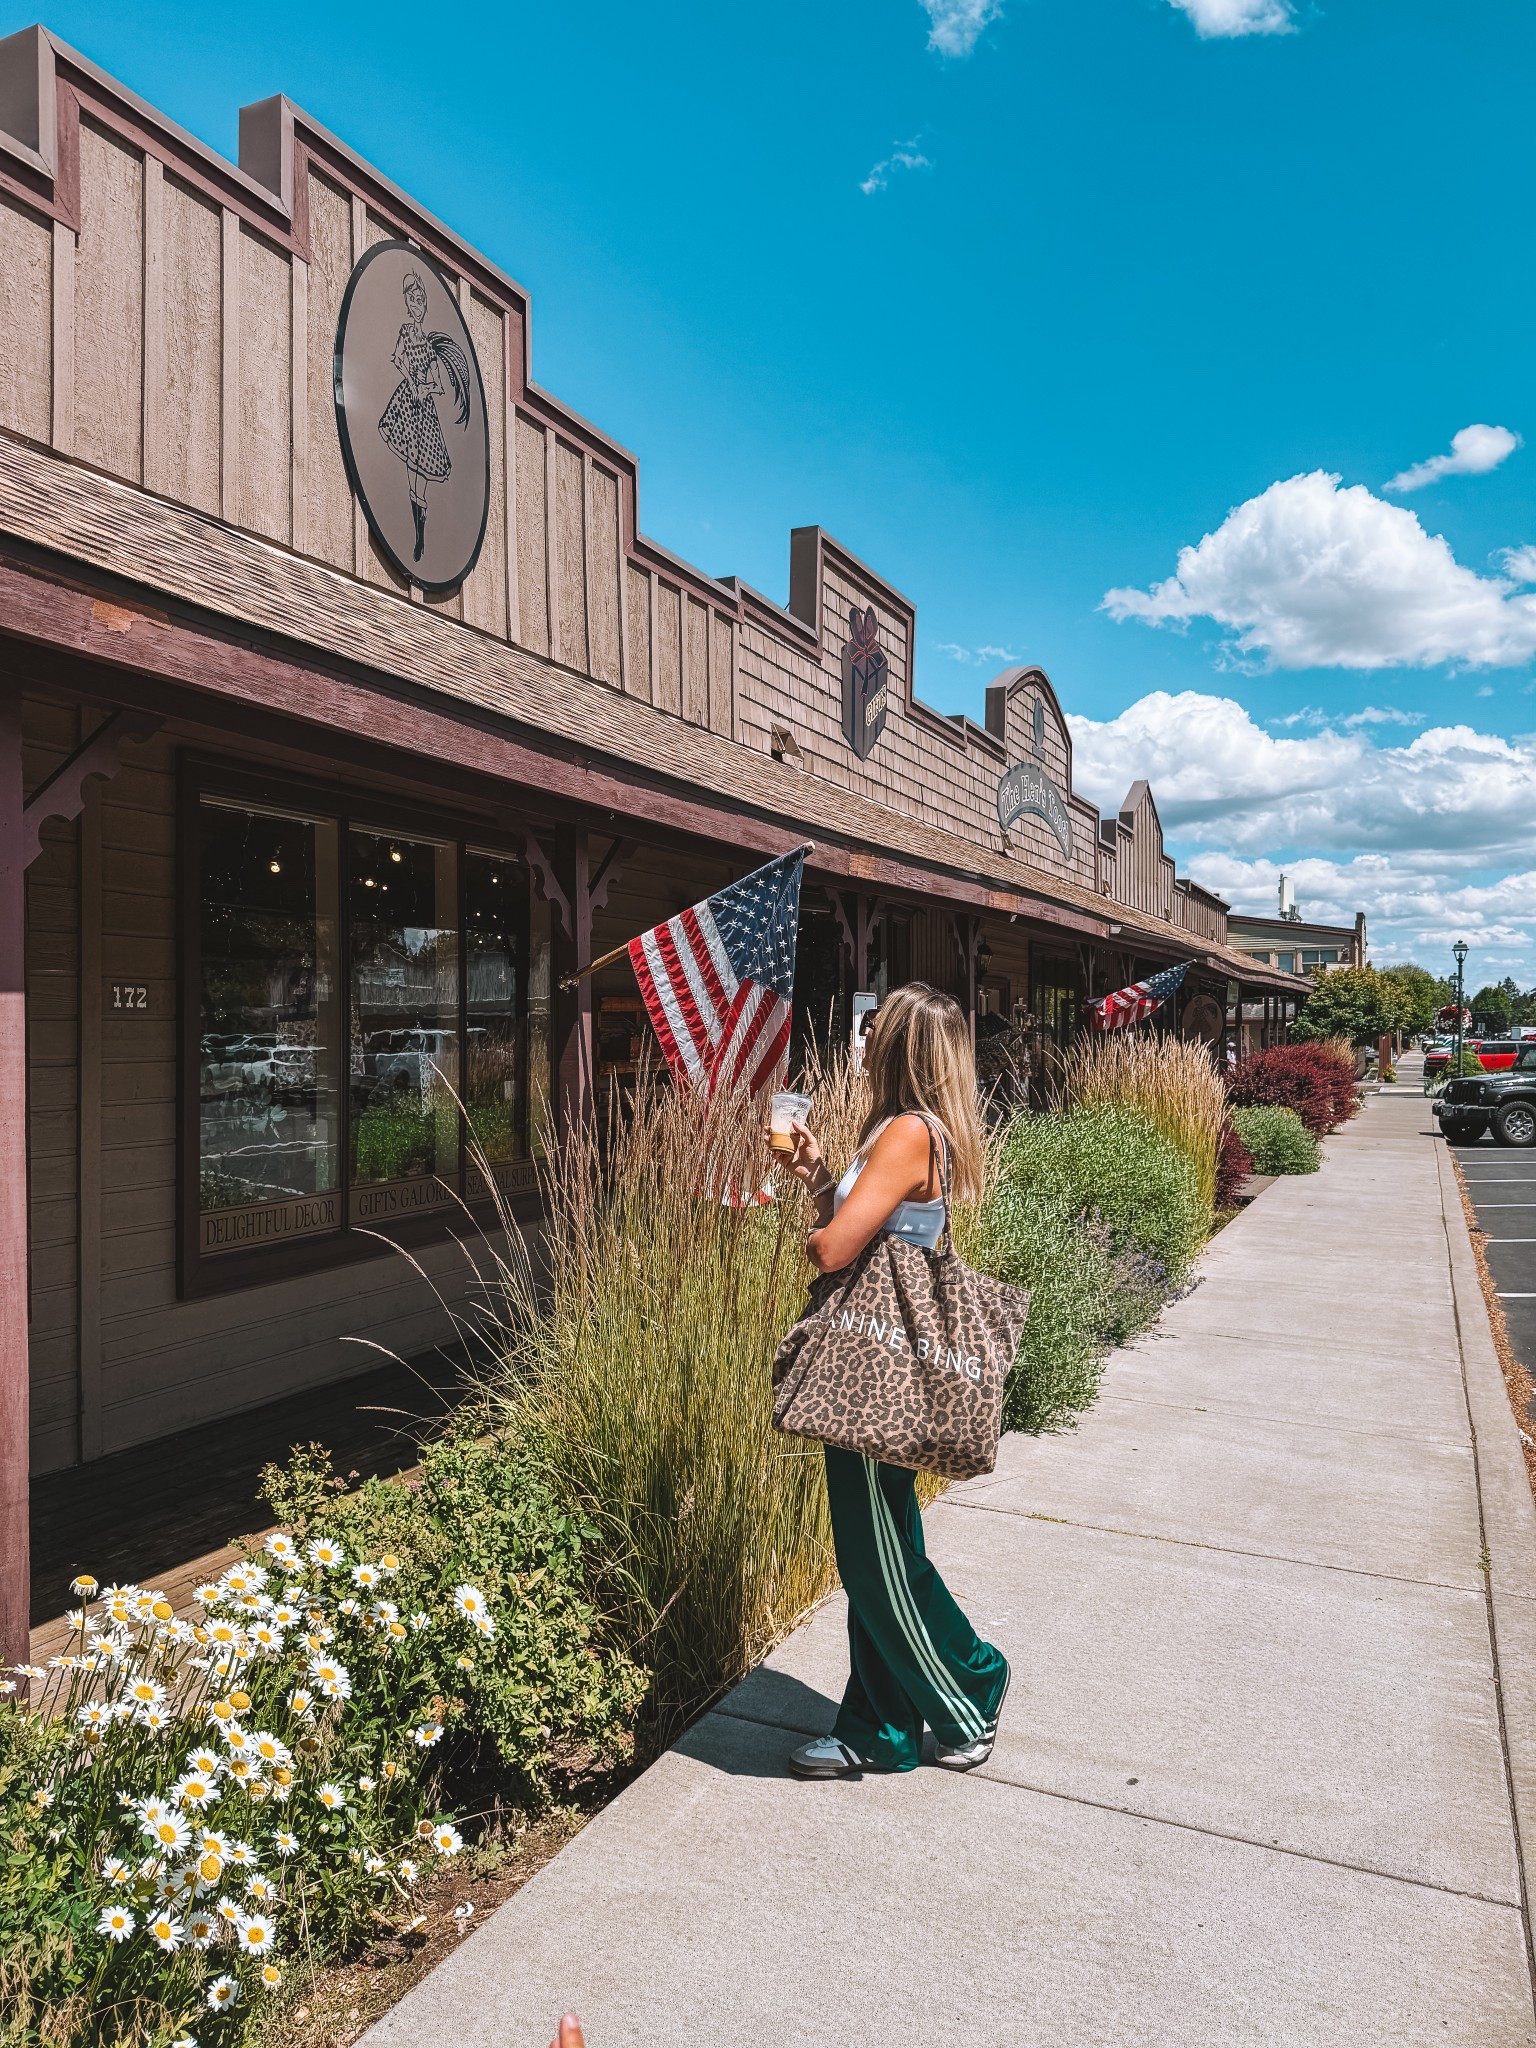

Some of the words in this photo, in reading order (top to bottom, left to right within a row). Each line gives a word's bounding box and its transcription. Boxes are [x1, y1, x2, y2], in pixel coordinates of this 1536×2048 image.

[866, 684, 886, 726] GIFTS
[1001, 781, 1020, 819] The
[1020, 775, 1046, 808] Hen's
[113, 986, 147, 1008] 172
[358, 1189, 397, 1216] GIFTS
[400, 1181, 450, 1209] GALORE
[206, 1207, 292, 1246] DELIGHTFUL
[294, 1200, 335, 1229] DECOR
[916, 1338, 981, 1379] BING
